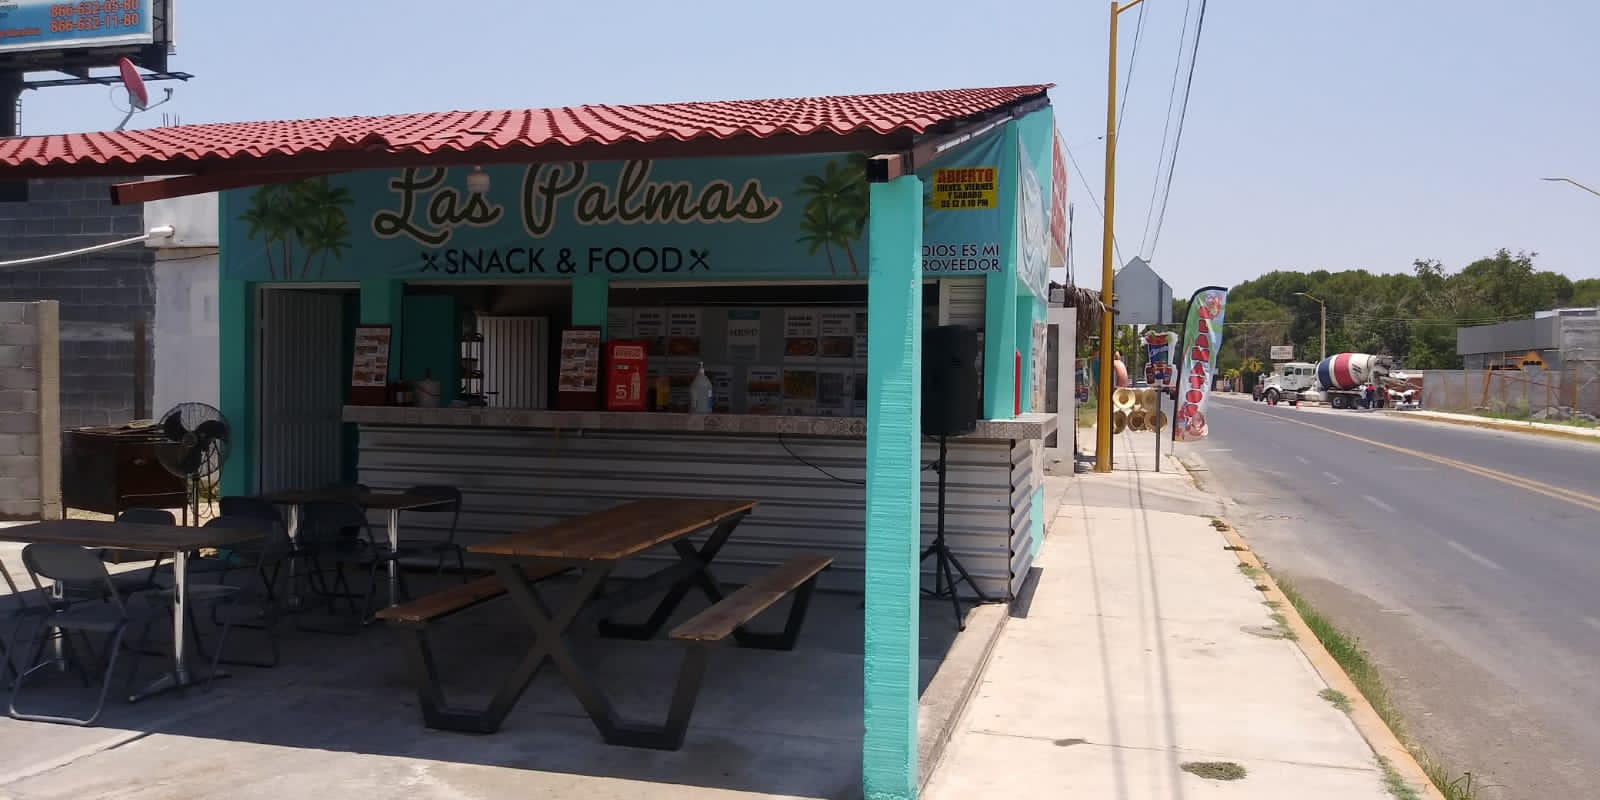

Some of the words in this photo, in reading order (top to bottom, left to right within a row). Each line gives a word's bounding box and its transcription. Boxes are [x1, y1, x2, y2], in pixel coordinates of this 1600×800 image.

[51, 13, 139, 32] 866-632-11-80
[938, 169, 993, 183] ABIERTO
[965, 183, 993, 191] VIERNES
[373, 167, 503, 247] Las
[522, 160, 782, 238] Palmas
[977, 199, 989, 207] PM
[922, 245, 956, 257] DIOS
[962, 244, 977, 256] ES
[982, 243, 999, 256] MI
[444, 248, 546, 274] SNACK
[556, 247, 577, 274] &
[589, 247, 682, 273] FOOD
[922, 258, 1000, 271] ROVEEDOR
[615, 384, 627, 400] 5
